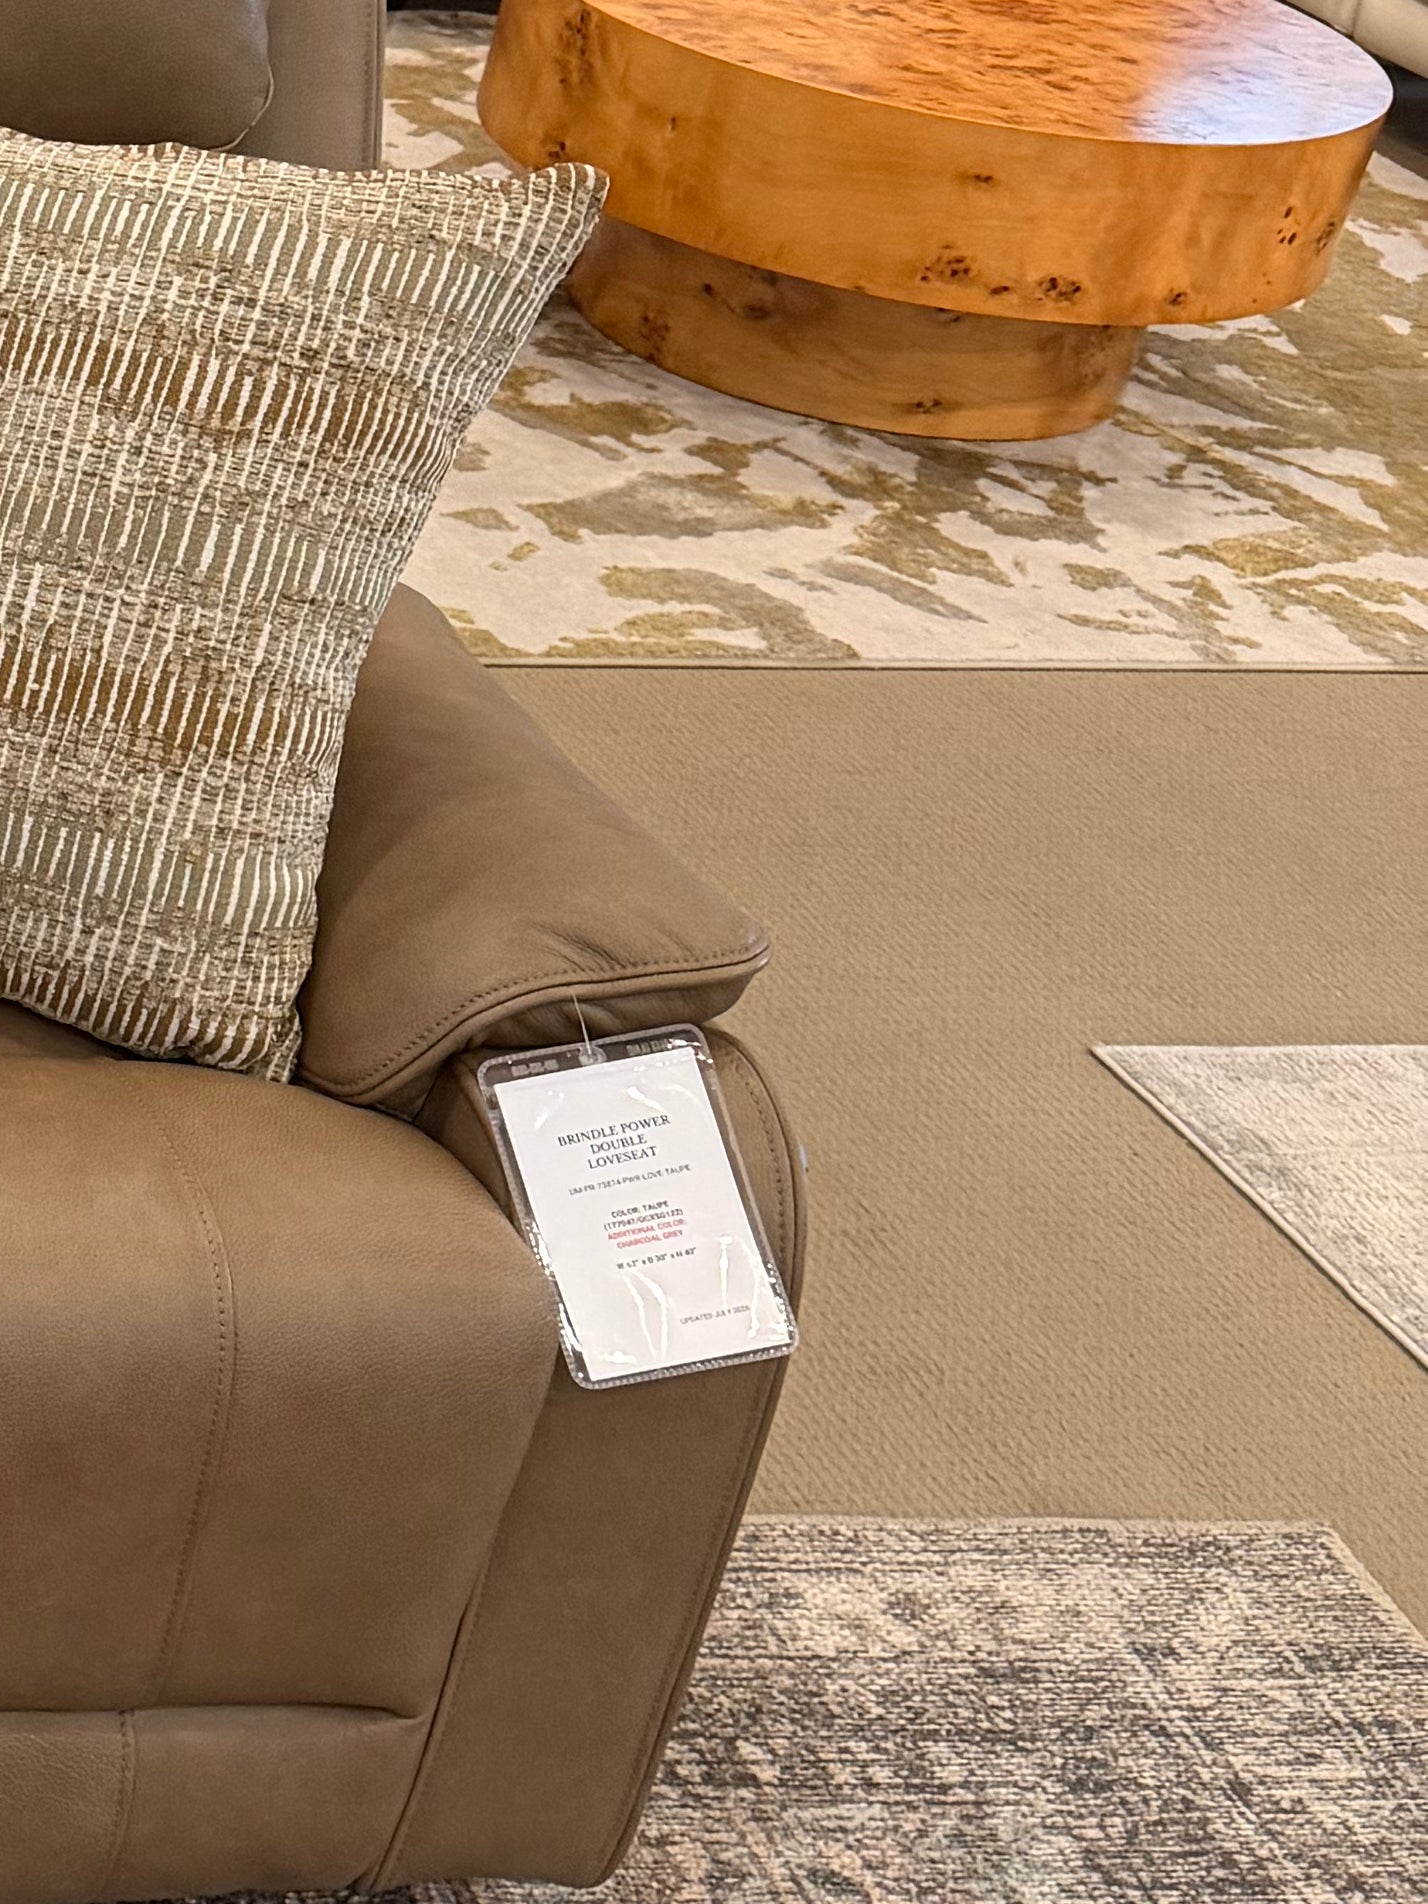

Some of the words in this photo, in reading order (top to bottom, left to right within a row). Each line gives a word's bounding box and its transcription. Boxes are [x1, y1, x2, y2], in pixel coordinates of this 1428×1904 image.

[557, 1125, 618, 1146] BRINDLE
[620, 1114, 670, 1133] POWER
[590, 1133, 647, 1154] DOUBLE
[587, 1145, 657, 1169] LOVESEAT
